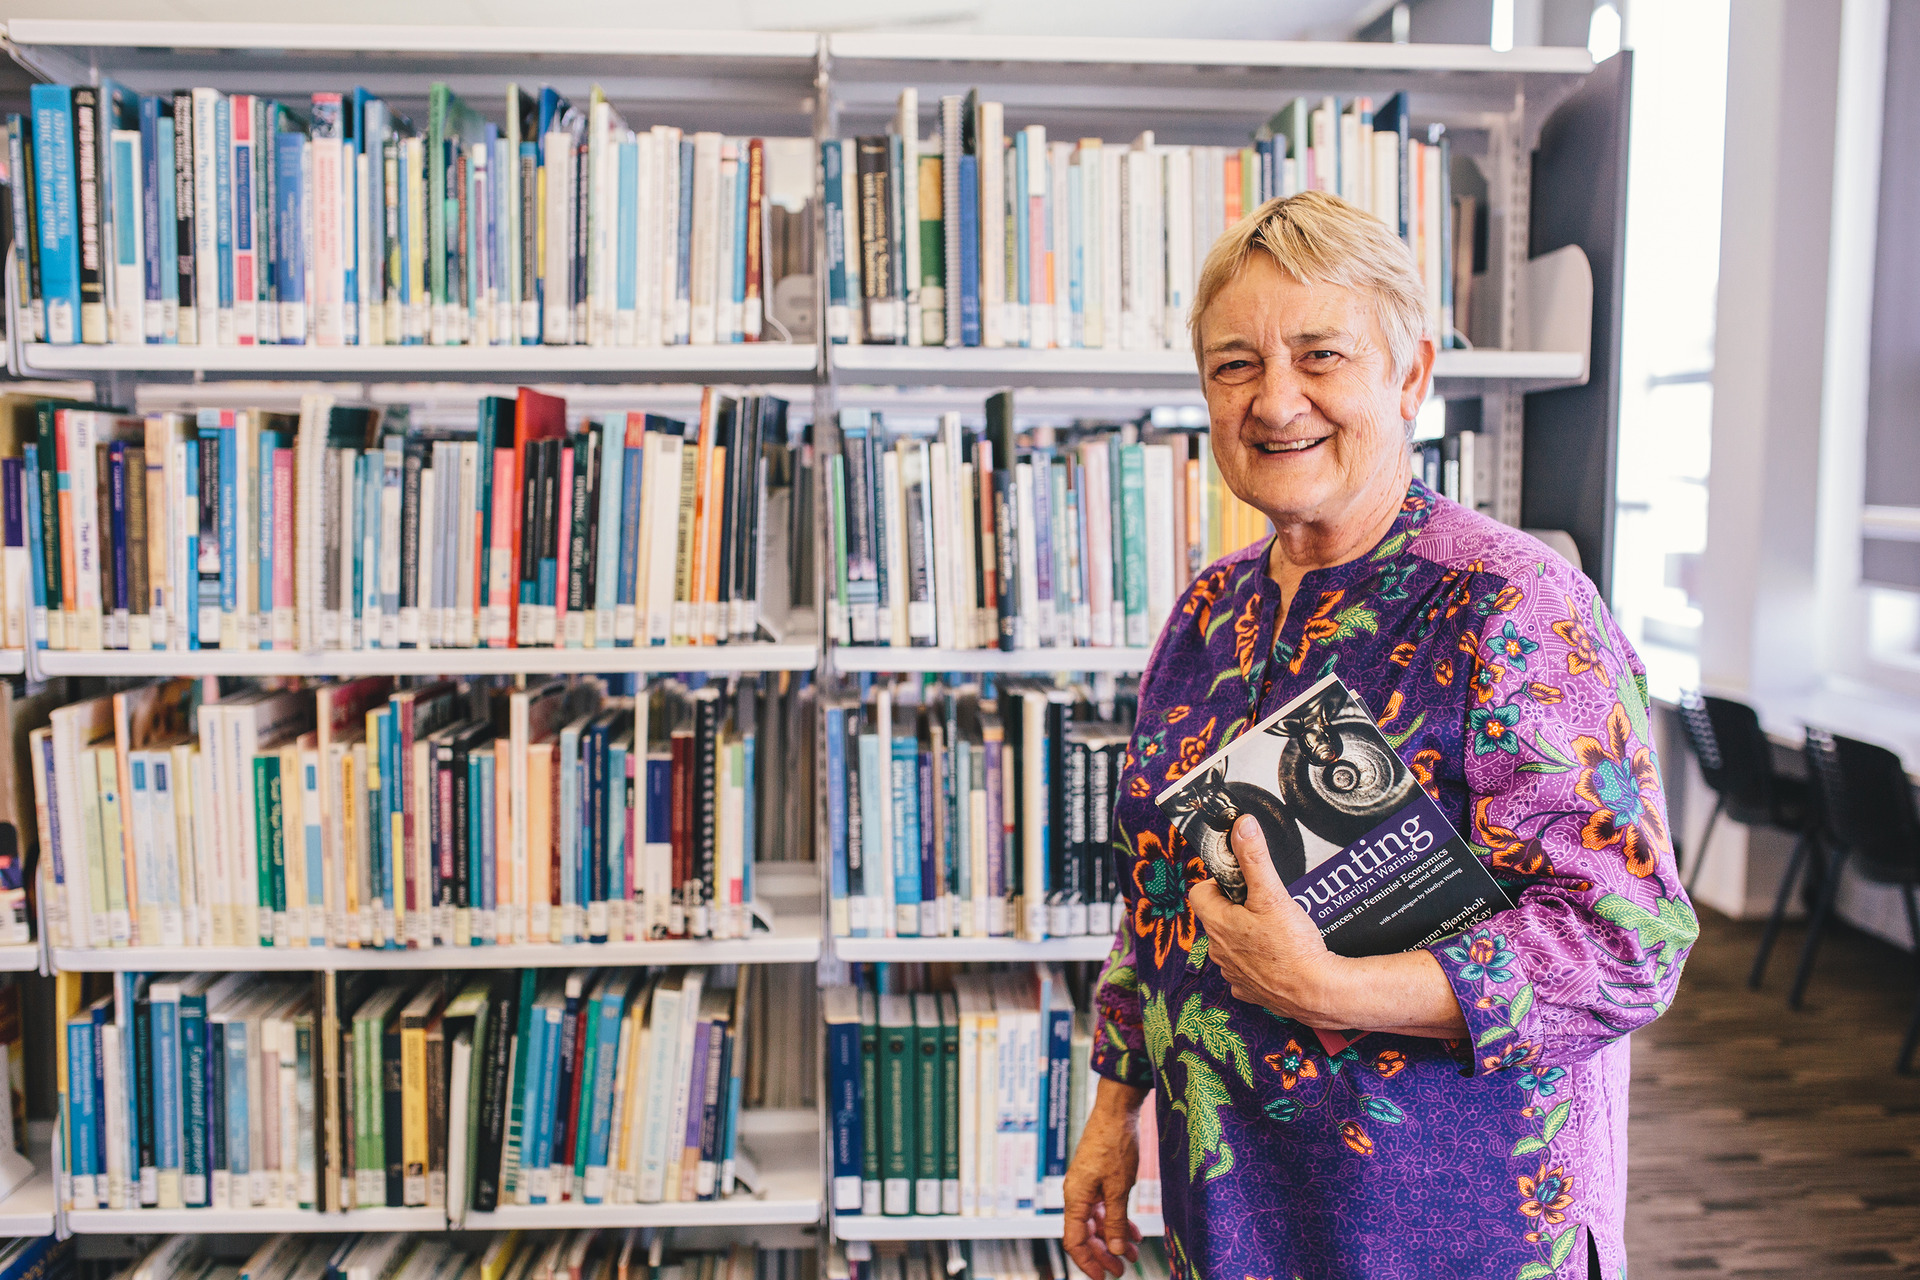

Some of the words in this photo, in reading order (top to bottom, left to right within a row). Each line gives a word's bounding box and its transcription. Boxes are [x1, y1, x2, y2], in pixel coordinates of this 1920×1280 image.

[1292, 814, 1434, 915] ounting
[1317, 905, 1334, 919] on
[1331, 876, 1378, 910] Marilyn
[1374, 850, 1418, 880] Waring
[1319, 911, 1355, 939] dvances
[1352, 904, 1365, 917] in
[1361, 879, 1403, 909] Feminist
[1399, 848, 1450, 884] Economics
[1408, 871, 1432, 890] second
[1430, 856, 1455, 875] edition
[1378, 915, 1392, 927] with
[1390, 910, 1399, 919] an
[1397, 897, 1419, 914] epilogue
[1416, 892, 1426, 901] by
[1423, 878, 1446, 896] Marilyn
[1442, 867, 1463, 882] Waring
[1440, 896, 1488, 932] Bjørnholt
[1457, 907, 1493, 934] McKay
